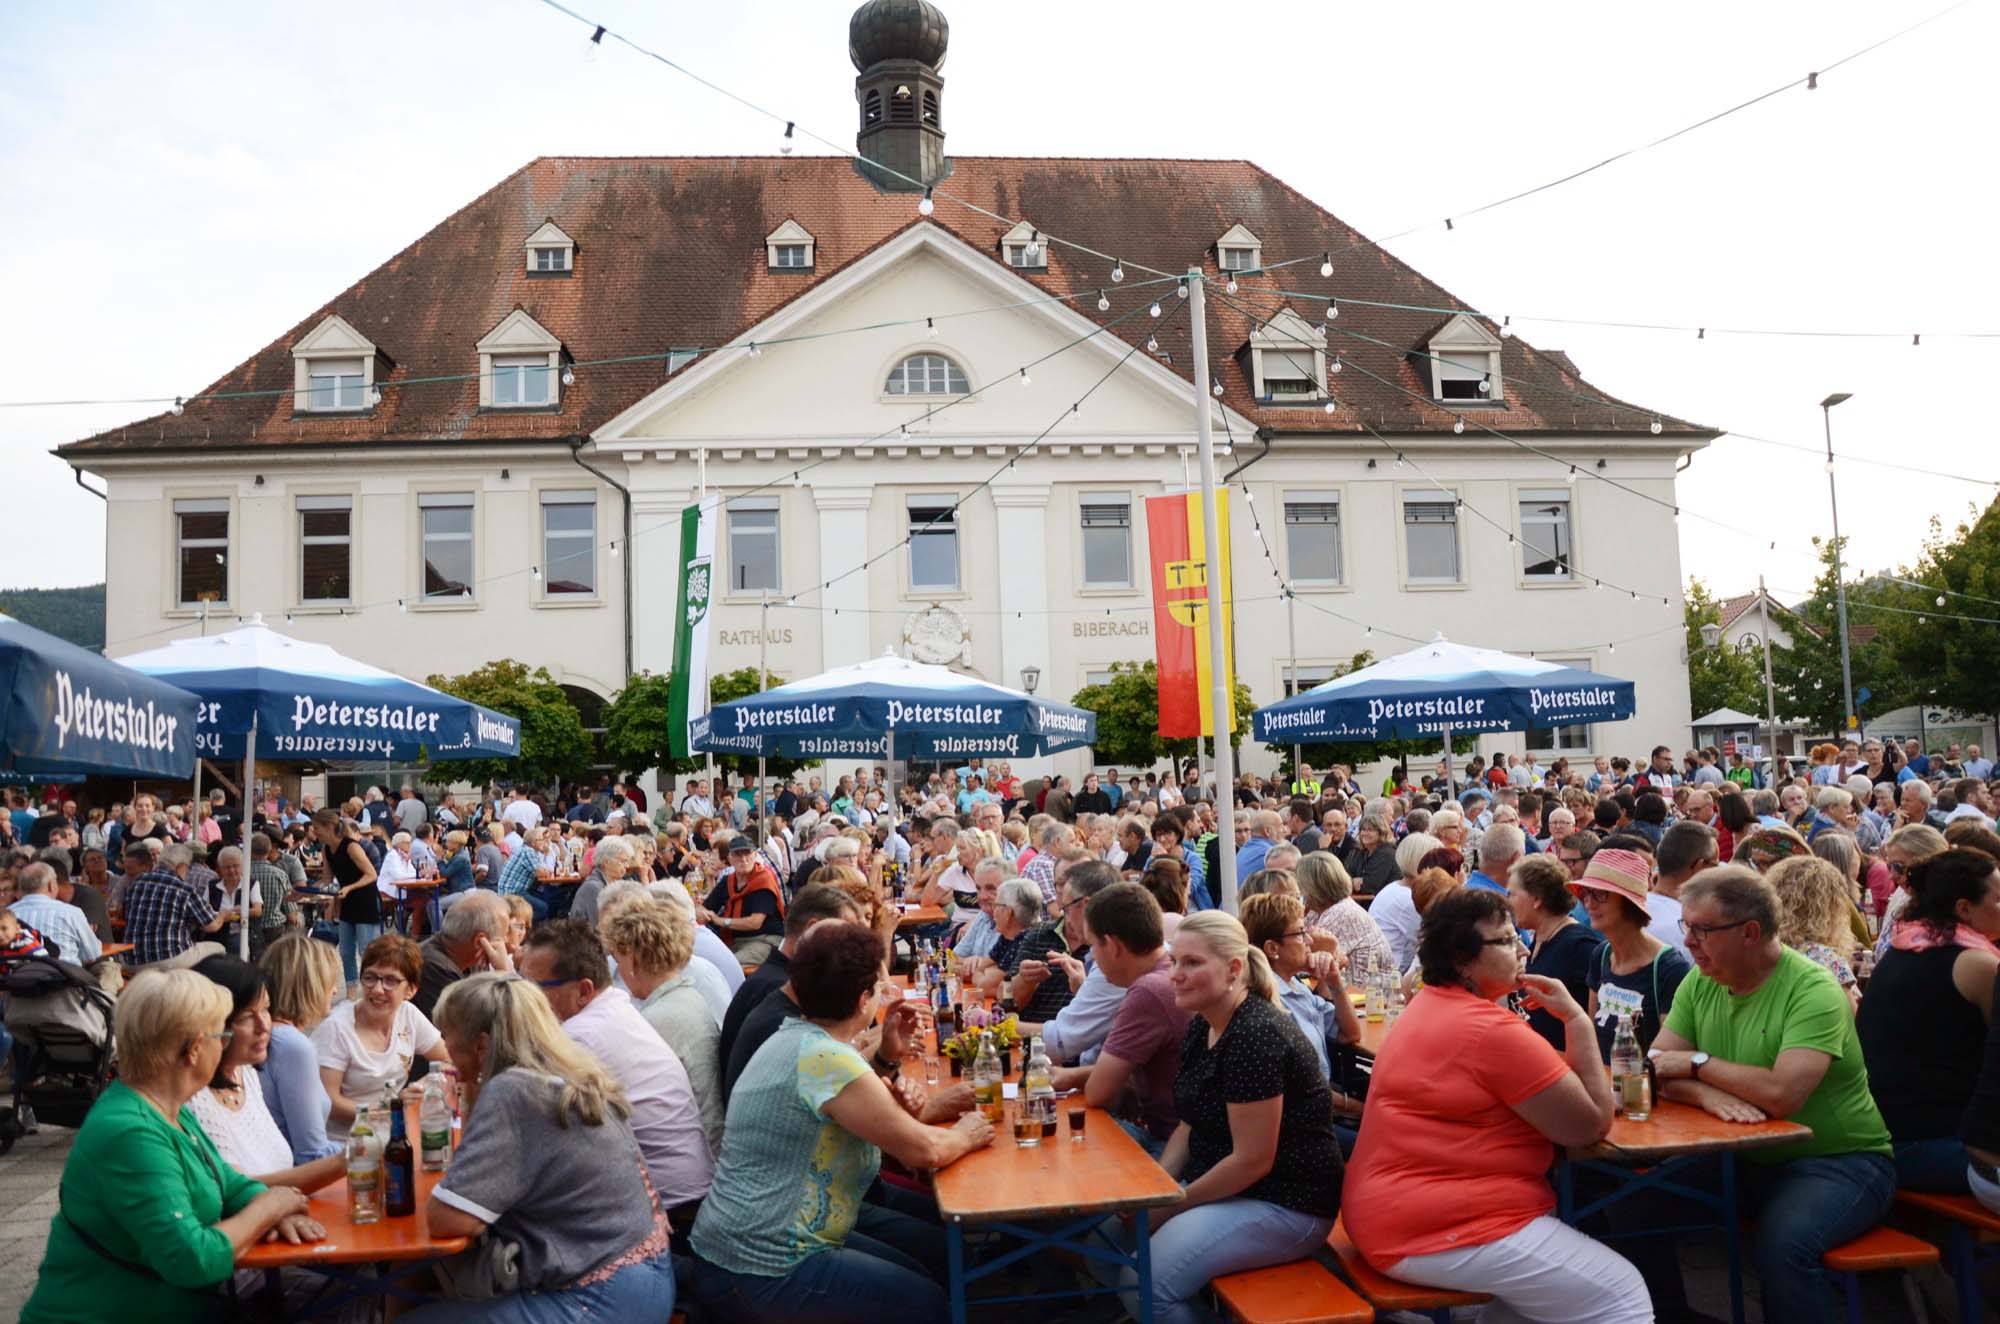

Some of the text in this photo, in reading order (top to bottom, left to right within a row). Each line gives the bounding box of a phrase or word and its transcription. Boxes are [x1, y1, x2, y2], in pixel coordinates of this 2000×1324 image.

[719, 629, 793, 645] RATHAUS
[1073, 622, 1149, 637] BIBERACH
[55, 670, 178, 752] Peterstaler
[291, 695, 440, 732] Peterstaler
[886, 700, 1003, 727] Peterstaler
[1367, 698, 1486, 726] Peterstaler
[1529, 687, 1616, 714] Peterstaler
[477, 712, 514, 746] Peterstaler
[734, 703, 836, 733] Peterstaler
[1038, 706, 1087, 732] Peterstaler
[1263, 707, 1326, 736] Peterstaler
